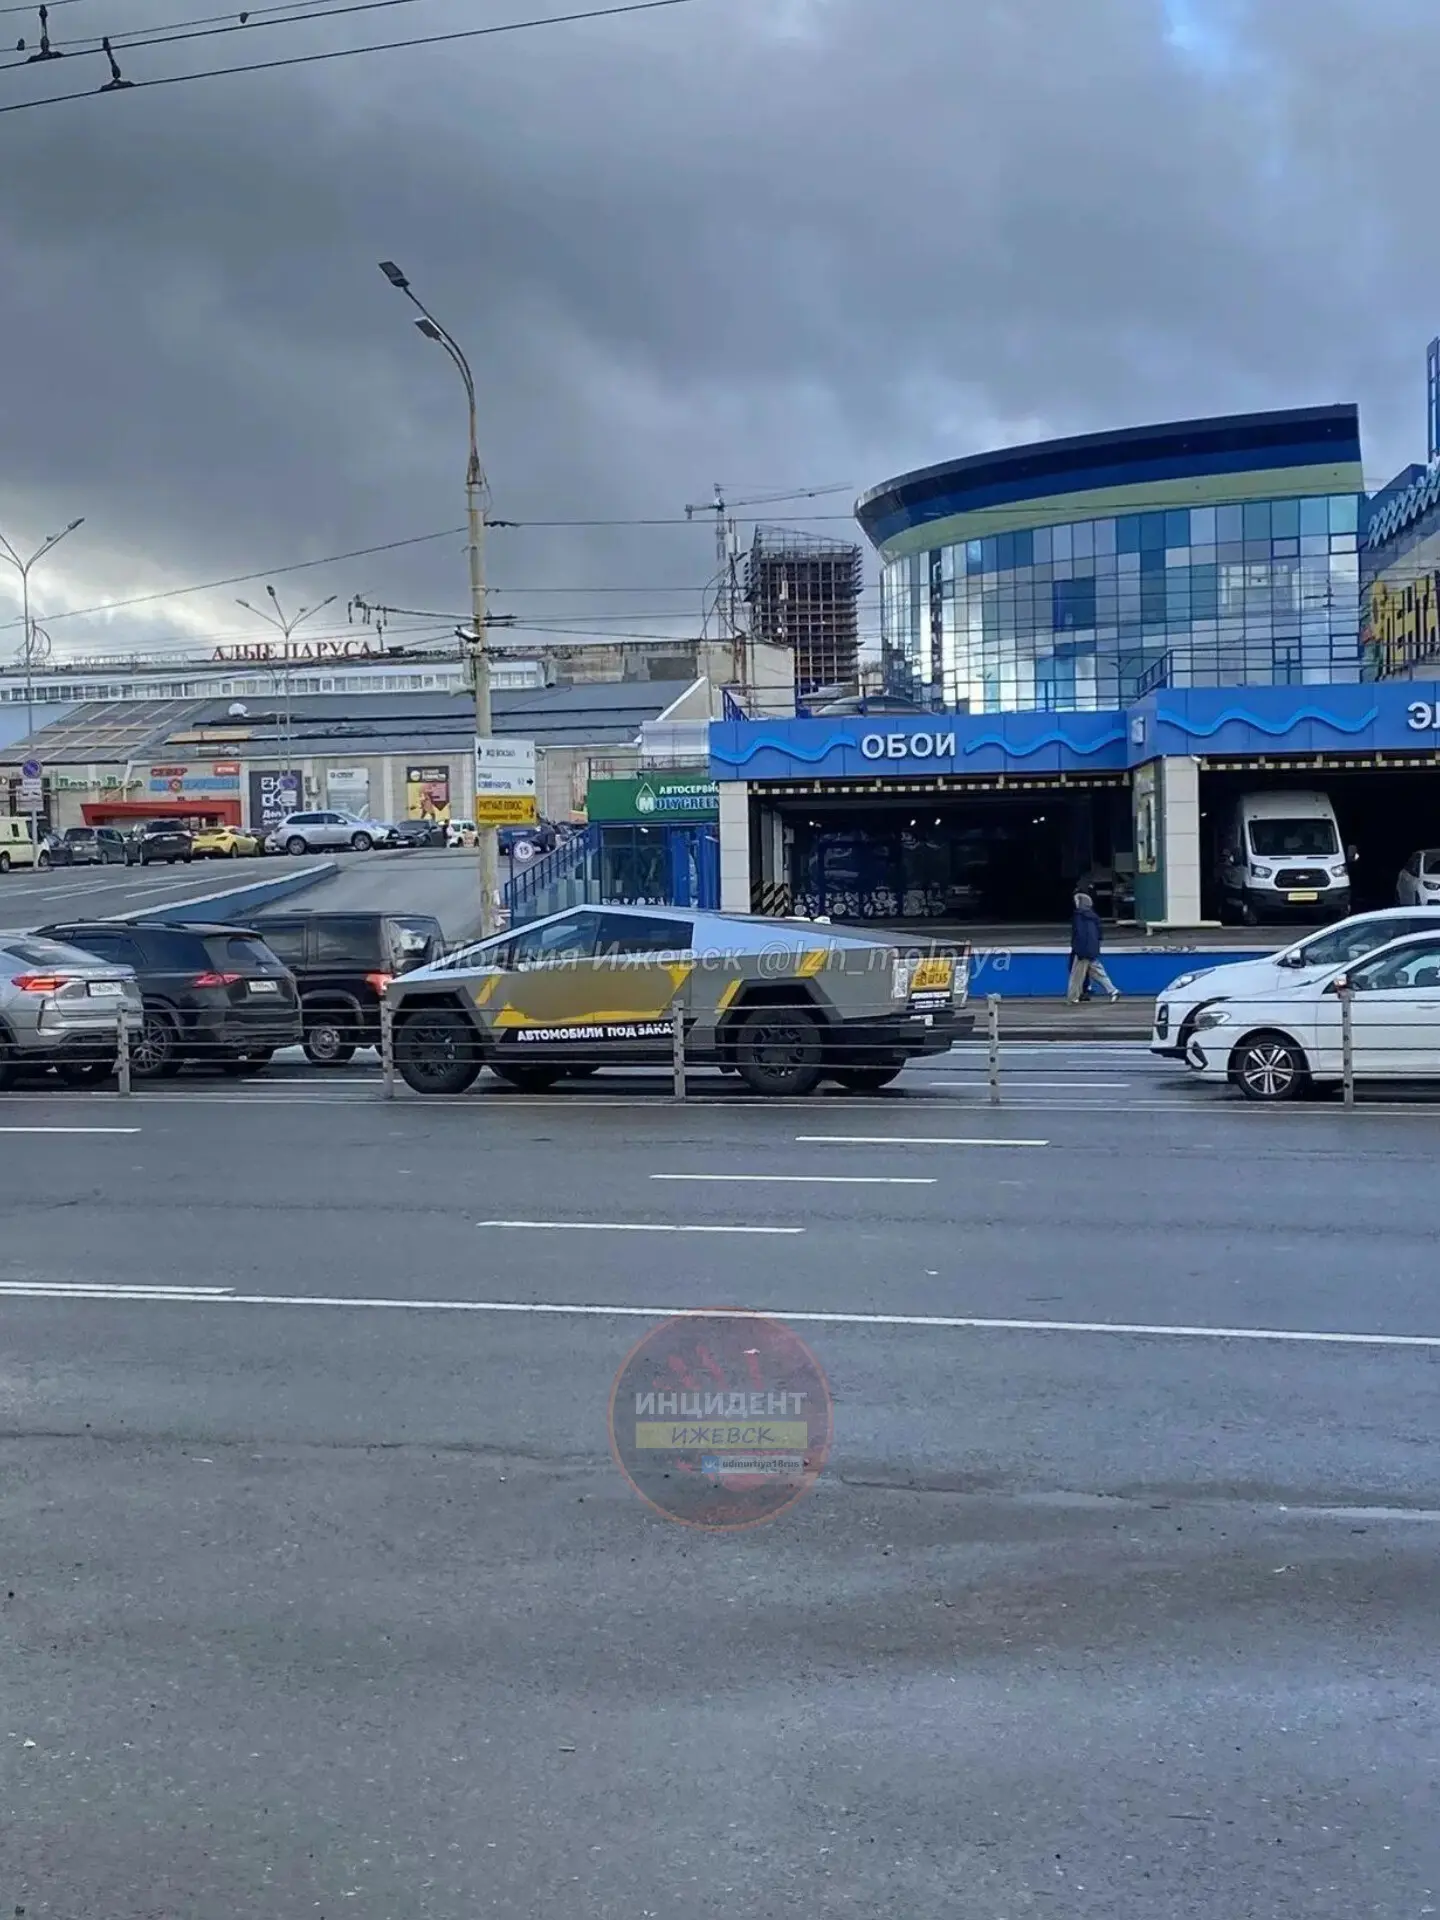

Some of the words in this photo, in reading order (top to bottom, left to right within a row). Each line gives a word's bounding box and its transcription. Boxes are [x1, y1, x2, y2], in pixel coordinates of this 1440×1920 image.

[861, 732, 956, 759] ОБОИ
[517, 1027, 604, 1041] АВТОМОБИЛИ
[607, 1024, 637, 1038] ПОД
